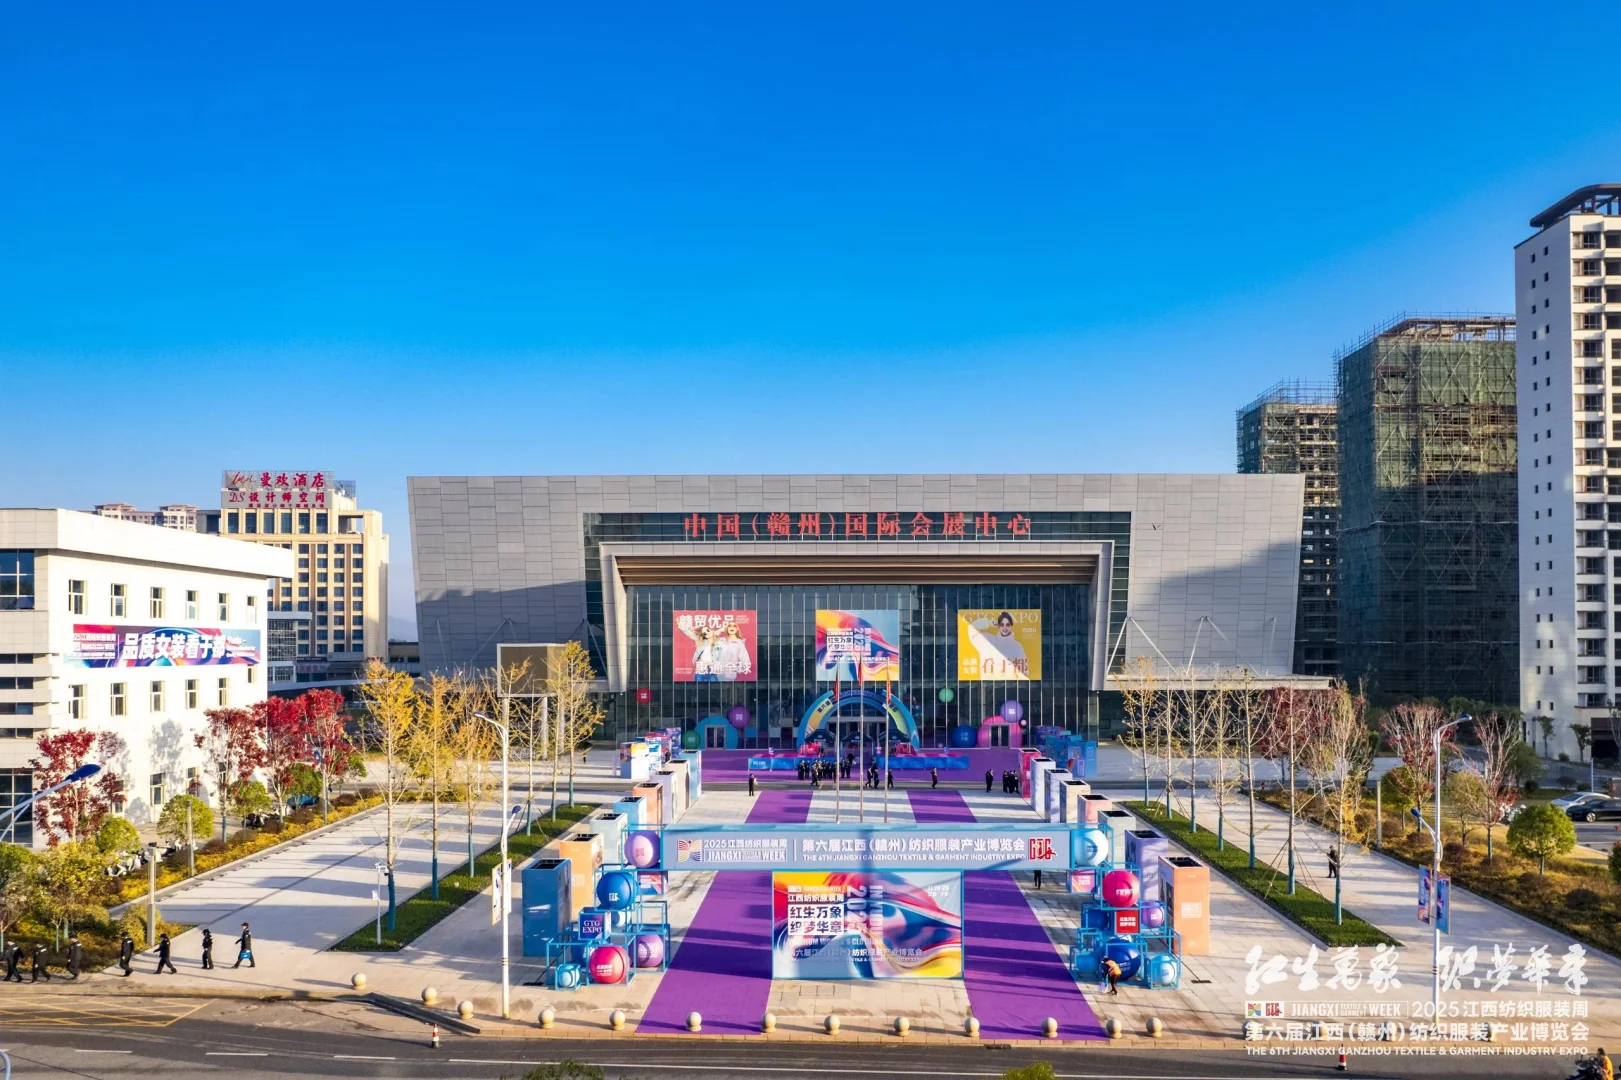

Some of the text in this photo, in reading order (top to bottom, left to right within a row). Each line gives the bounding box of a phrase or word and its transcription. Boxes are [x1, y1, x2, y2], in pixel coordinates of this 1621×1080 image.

[685, 512, 1031, 537] 中国（赣州）国际会展中心
[123, 633, 226, 660] 品质女装看于都
[802, 838, 1025, 852] 第六届江西（赣州）纺织服装产业博览会
[708, 851, 741, 860] JIANGXI
[763, 851, 785, 860] WEEK
[790, 906, 842, 918] 红生万象
[790, 920, 842, 933] 织梦华章
